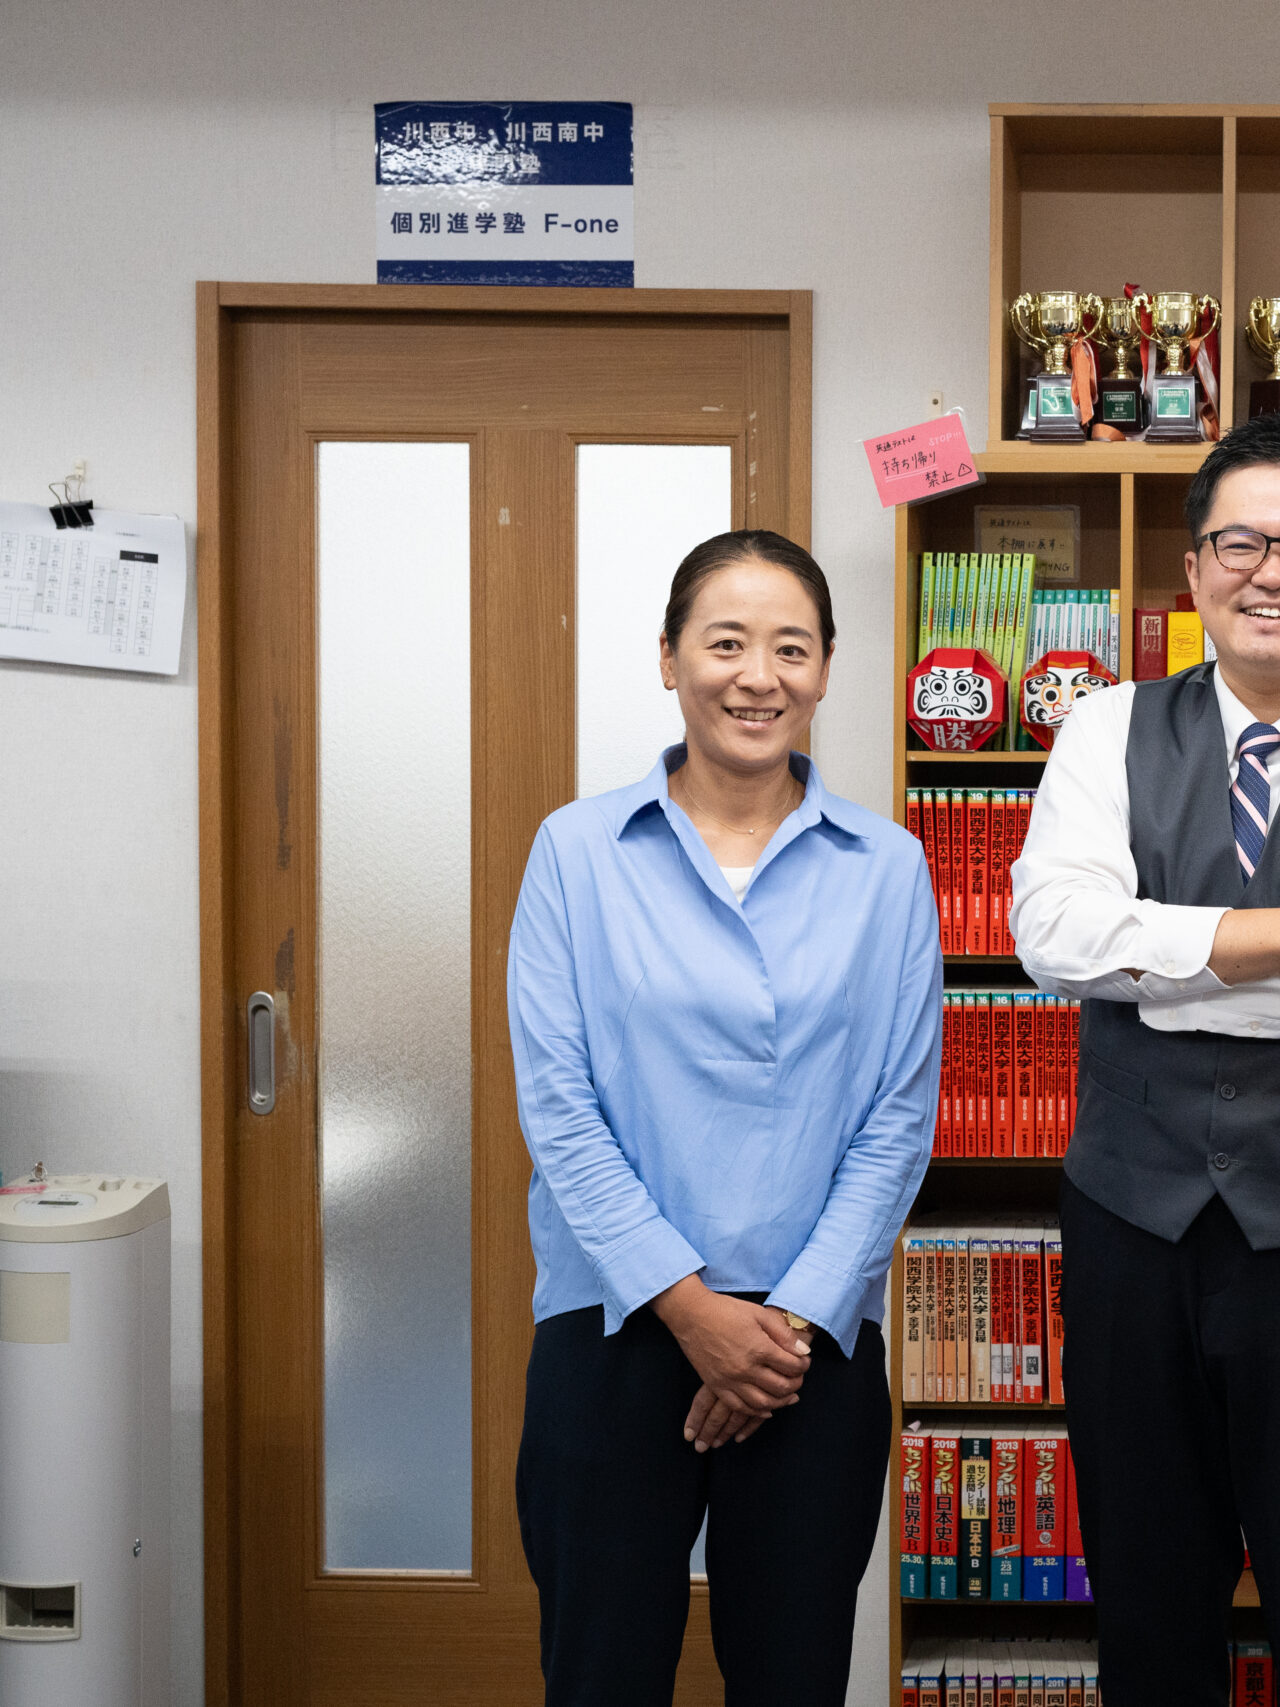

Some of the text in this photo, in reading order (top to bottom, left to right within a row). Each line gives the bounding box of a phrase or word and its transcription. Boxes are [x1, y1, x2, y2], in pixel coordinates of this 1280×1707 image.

[390, 212, 619, 234] 個別進学塾 F-one
[882, 450, 938, 475] 持ち帰り
[925, 469, 955, 488] 禁止
[933, 720, 973, 750] 勝
[908, 808, 919, 836] 関西学
[969, 808, 986, 866] 関西学院大学
[994, 1011, 1011, 1069] 関西学院大学
[1016, 1011, 1033, 1069] 関西学院大学
[906, 1257, 922, 1314] 関西学院大学
[973, 1257, 988, 1315] 関西学院大学
[1022, 1259, 1039, 1316] 関西学院大学
[902, 1437, 925, 1448] 2018
[933, 1440, 957, 1449] 2018
[996, 1441, 1018, 1450] 2013
[1033, 1440, 1057, 1449] 2018
[966, 1465, 976, 1516] 過去問レビュー
[976, 1465, 986, 1516] センター試験
[1035, 1497, 1055, 1531] 英語
